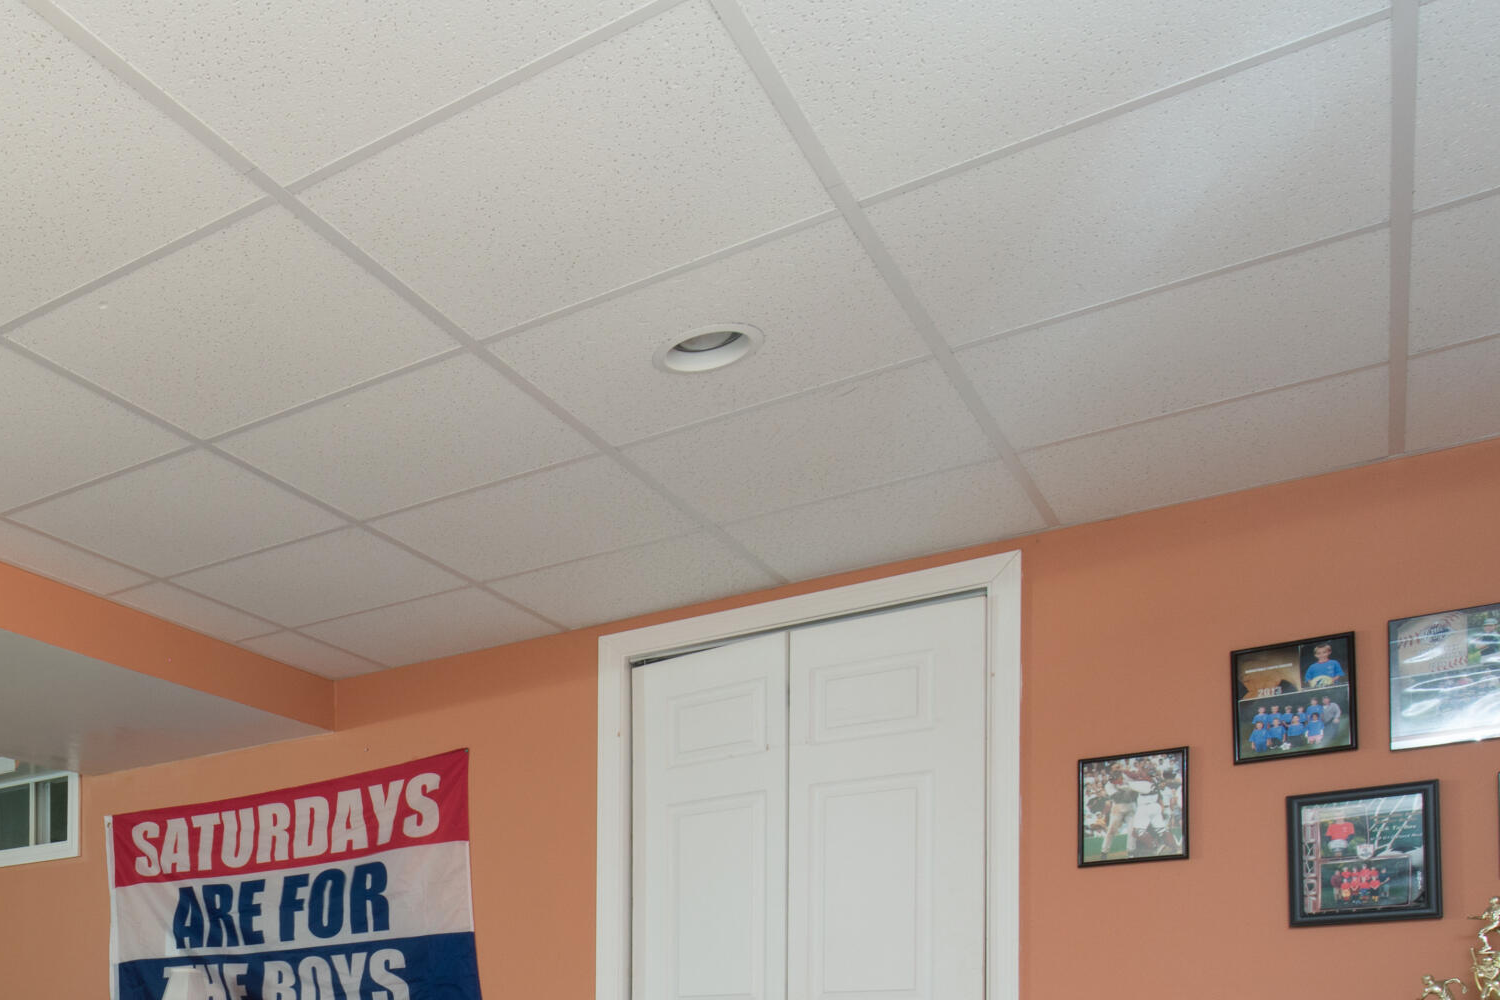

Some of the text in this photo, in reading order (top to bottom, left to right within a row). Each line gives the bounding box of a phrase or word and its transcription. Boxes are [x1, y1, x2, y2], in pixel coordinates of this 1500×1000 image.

[131, 772, 441, 877] SATURDAYS
[172, 861, 390, 949] ARE FOR
